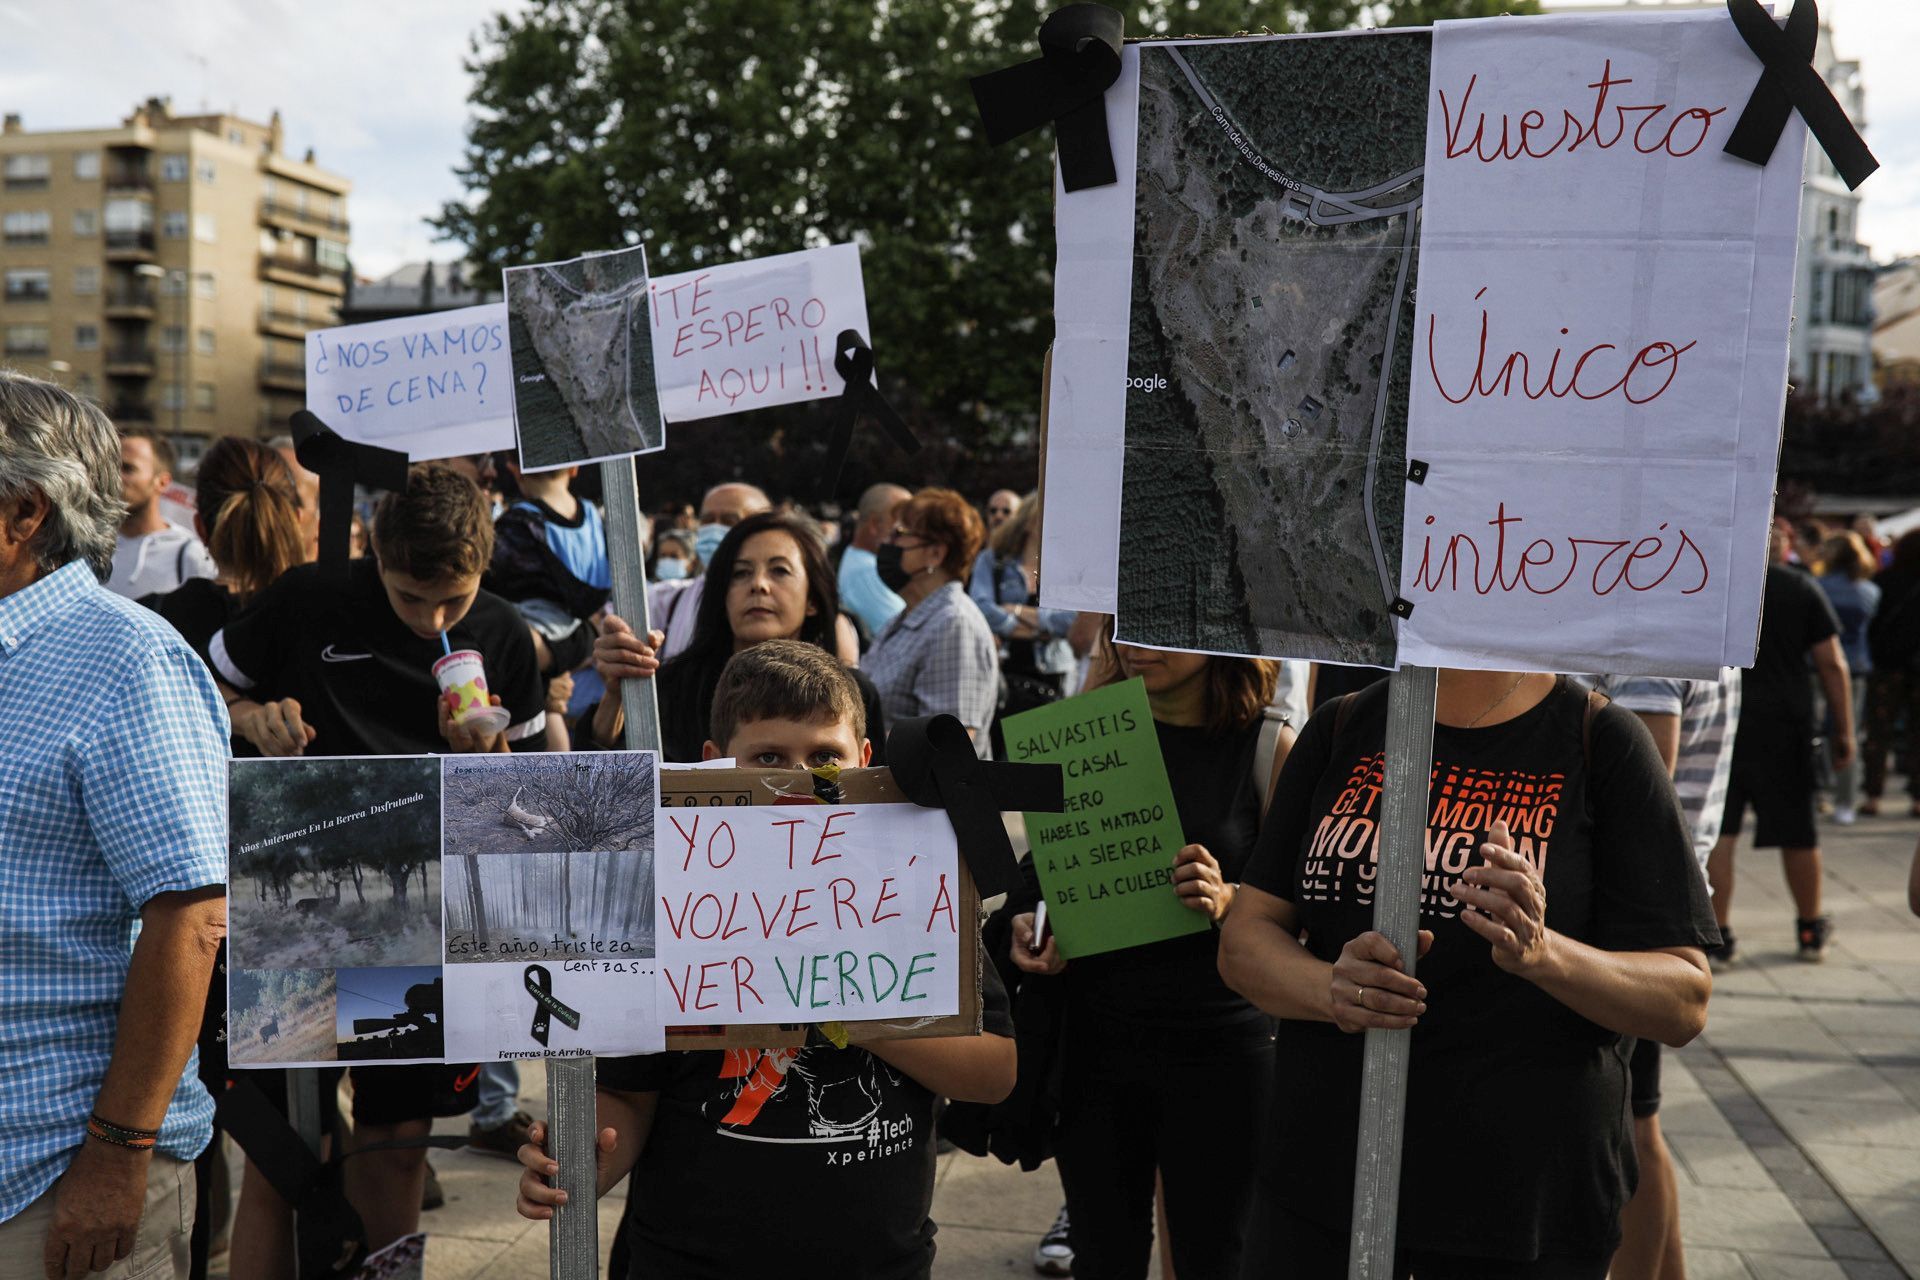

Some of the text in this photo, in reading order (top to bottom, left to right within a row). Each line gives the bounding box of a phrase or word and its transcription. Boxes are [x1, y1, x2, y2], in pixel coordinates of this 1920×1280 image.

[1438, 58, 1727, 162] Vuestro
[1211, 106, 1301, 191] Cam. de las Devesinas
[315, 324, 502, 374] ¿NOS VAMOS
[673, 298, 826, 358] ESPERO
[1428, 286, 1698, 403] Único
[337, 361, 487, 413] DE CENA?
[1126, 373, 1167, 393] oogle
[1412, 502, 1709, 596] interés
[1016, 709, 1137, 760] SALVASTEIS
[1067, 750, 1128, 778] CASAL
[238, 791, 424, 855] Años Anteriores En La Berrea Disfrutando
[1063, 790, 1104, 814] PERO
[1431, 797, 1558, 838] MOVING
[669, 811, 856, 872] YO TE
[1039, 805, 1164, 845] HABEIS MATADO
[1048, 835, 1163, 873] A LA SIERRA
[1056, 887, 1079, 905] DE
[1088, 883, 1110, 900] LA
[448, 933, 489, 954] Este
[663, 951, 937, 1014] VER VERDE
[498, 1047, 592, 1059] Ferreras De Arriba
[827, 1136, 913, 1166] Xperience
[867, 1113, 913, 1148] #Tech
